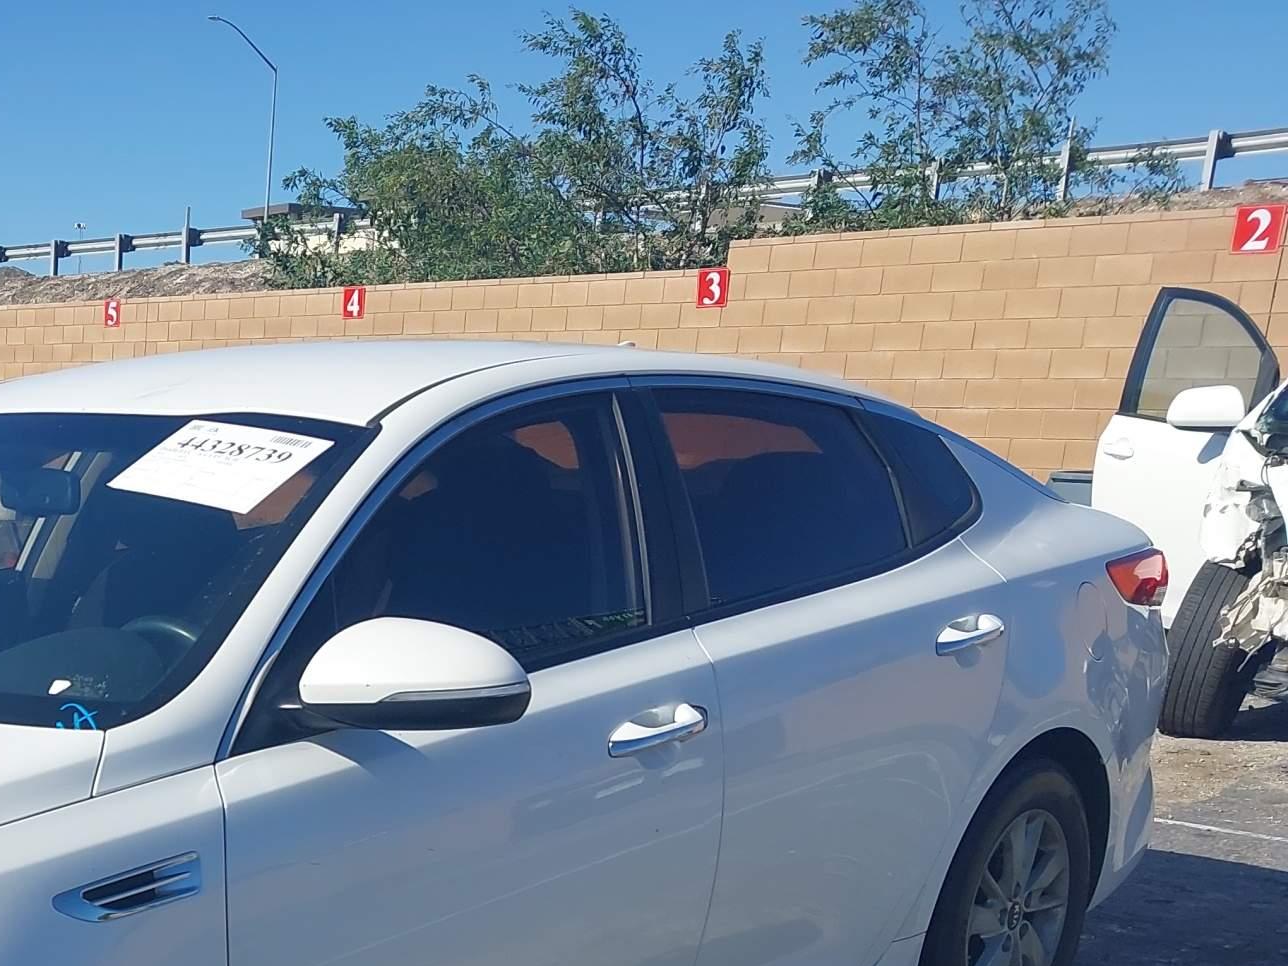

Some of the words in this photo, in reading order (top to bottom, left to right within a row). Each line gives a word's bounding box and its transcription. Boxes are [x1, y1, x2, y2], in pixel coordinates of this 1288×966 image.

[1239, 208, 1272, 251] 2
[346, 288, 360, 317] 4
[702, 271, 721, 305] 3
[107, 301, 118, 326] 5
[177, 436, 293, 464] 44328739
